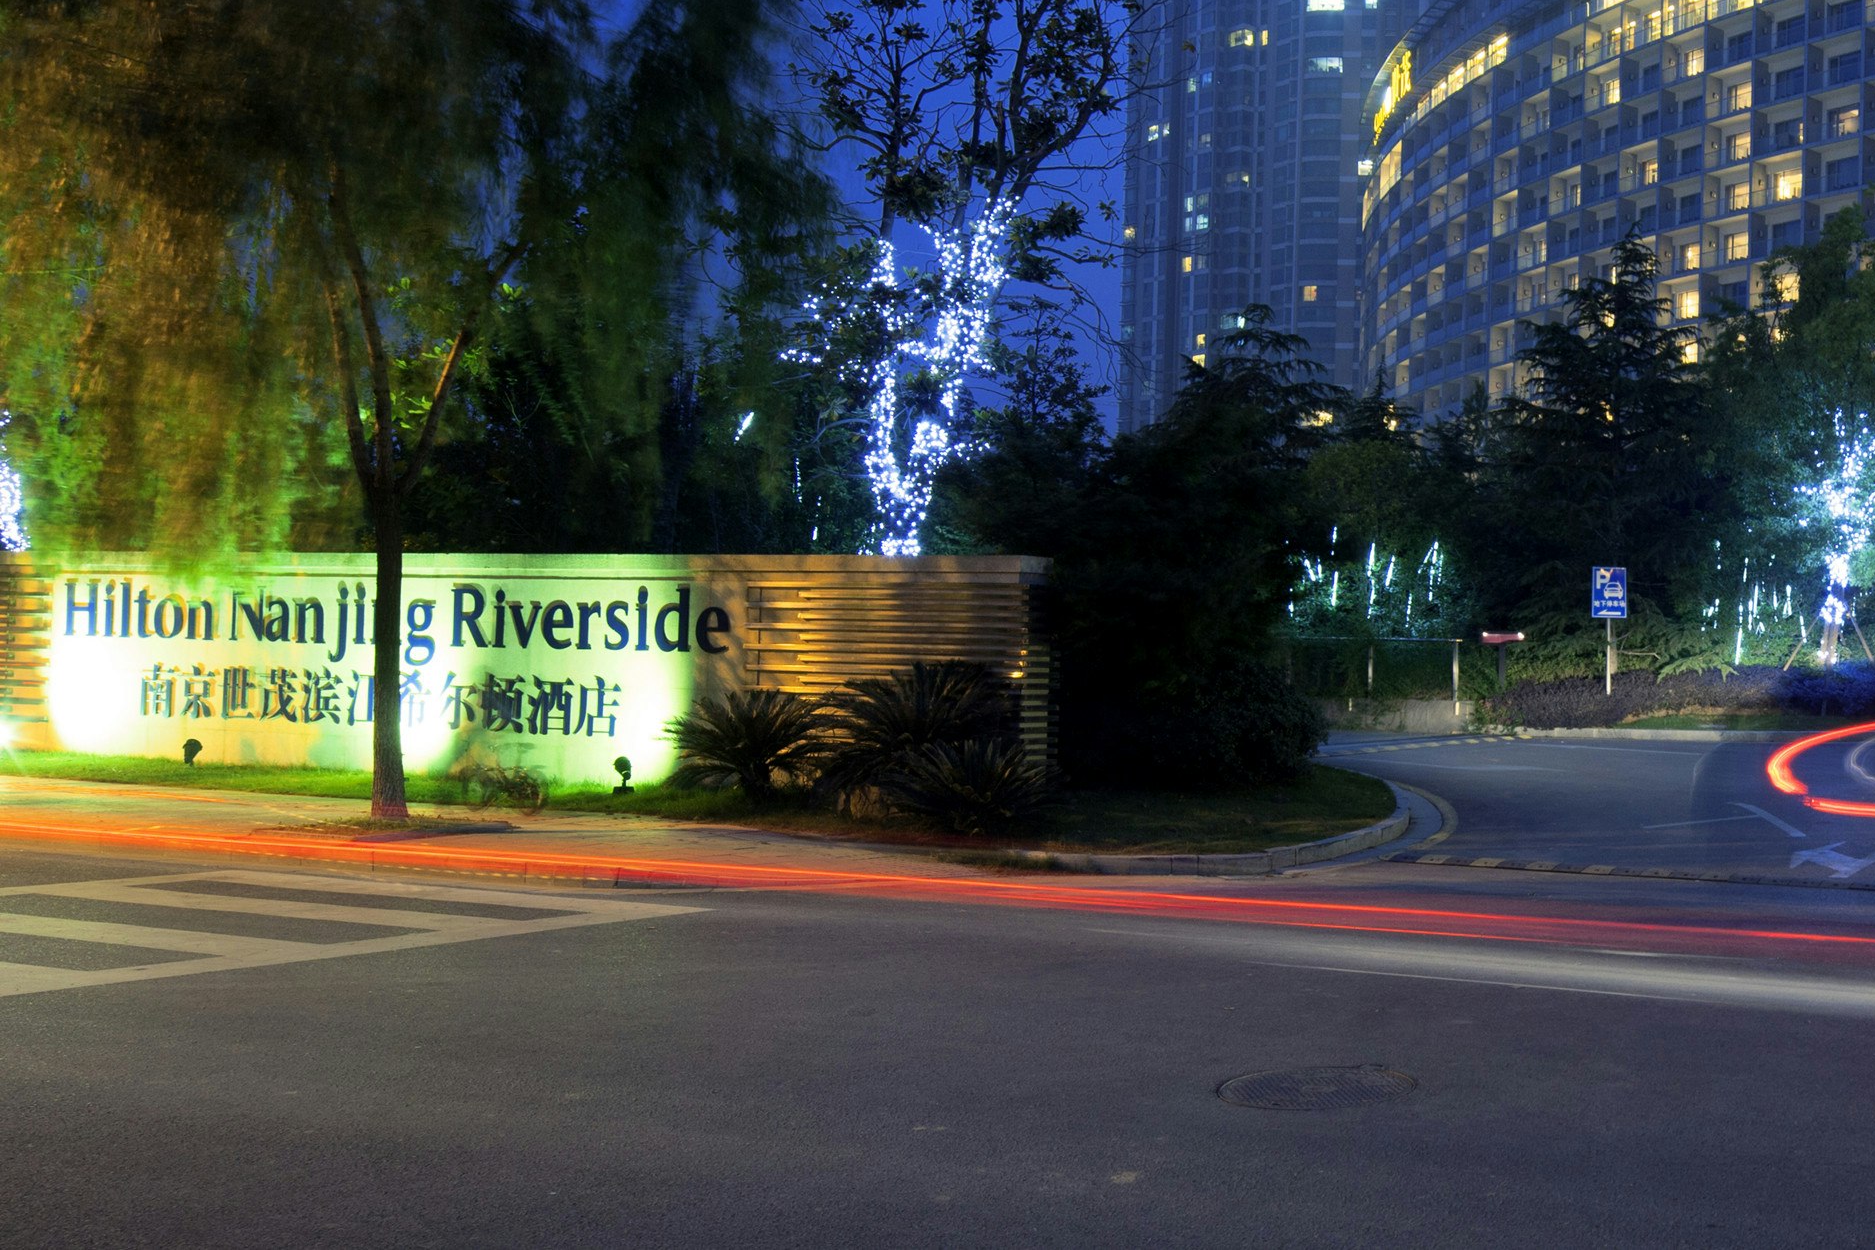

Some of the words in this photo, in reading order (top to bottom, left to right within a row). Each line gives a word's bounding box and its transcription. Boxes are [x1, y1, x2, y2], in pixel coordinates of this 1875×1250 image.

[1596, 570, 1610, 589] P
[63, 577, 217, 640] Hilton
[449, 583, 731, 654] Riverside
